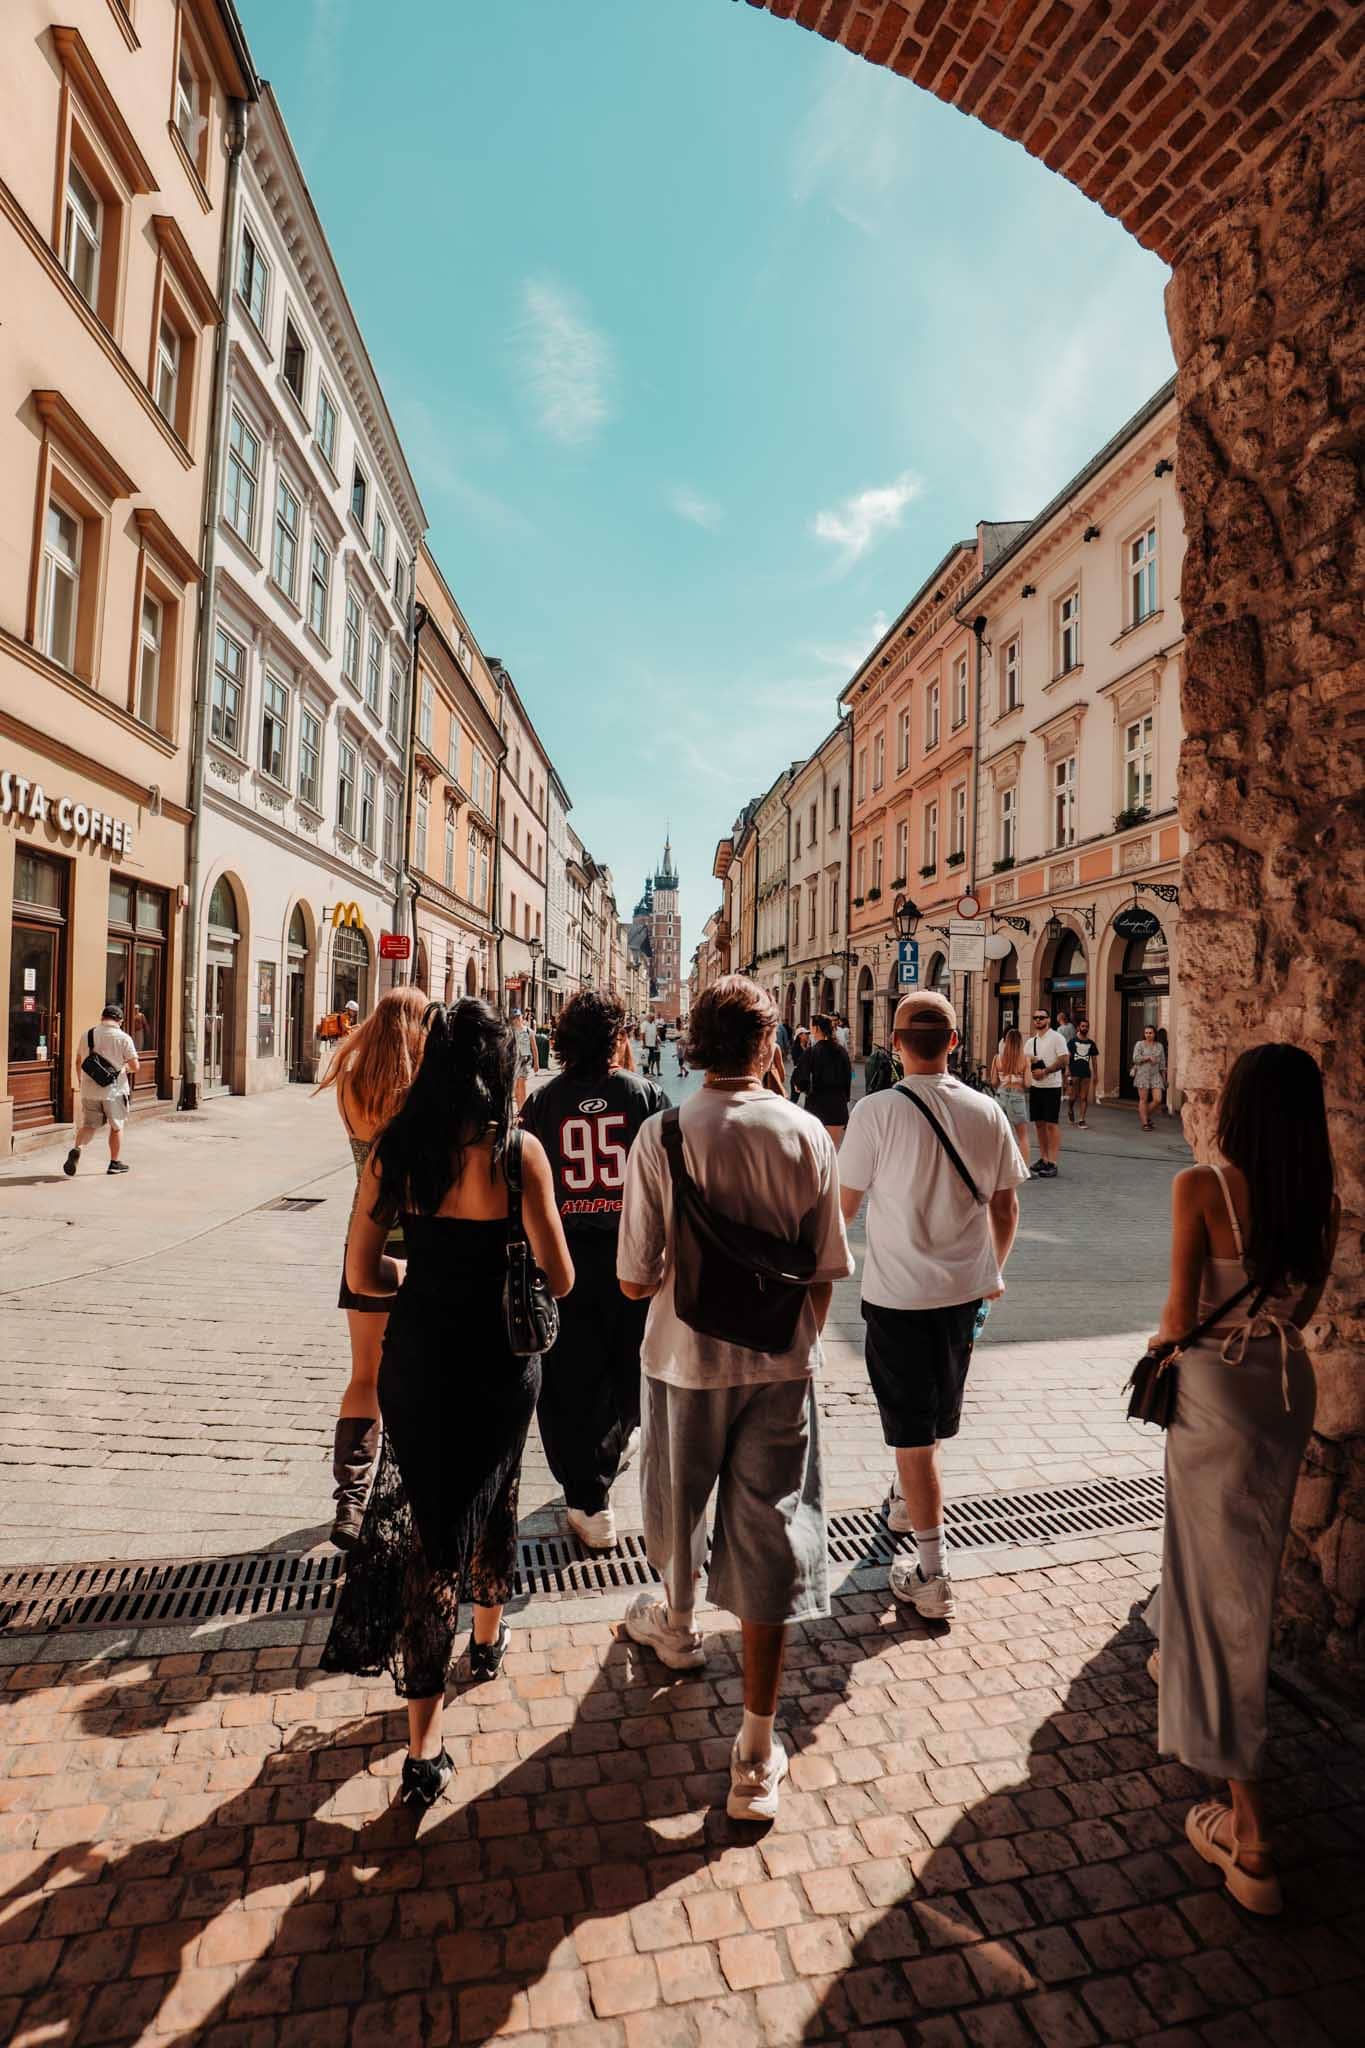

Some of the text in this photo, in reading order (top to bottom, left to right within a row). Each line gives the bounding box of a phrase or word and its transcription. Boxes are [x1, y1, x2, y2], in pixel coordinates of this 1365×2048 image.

[58, 796, 133, 854] COFFEE
[903, 964, 915, 981] P
[561, 1114, 627, 1191] 95
